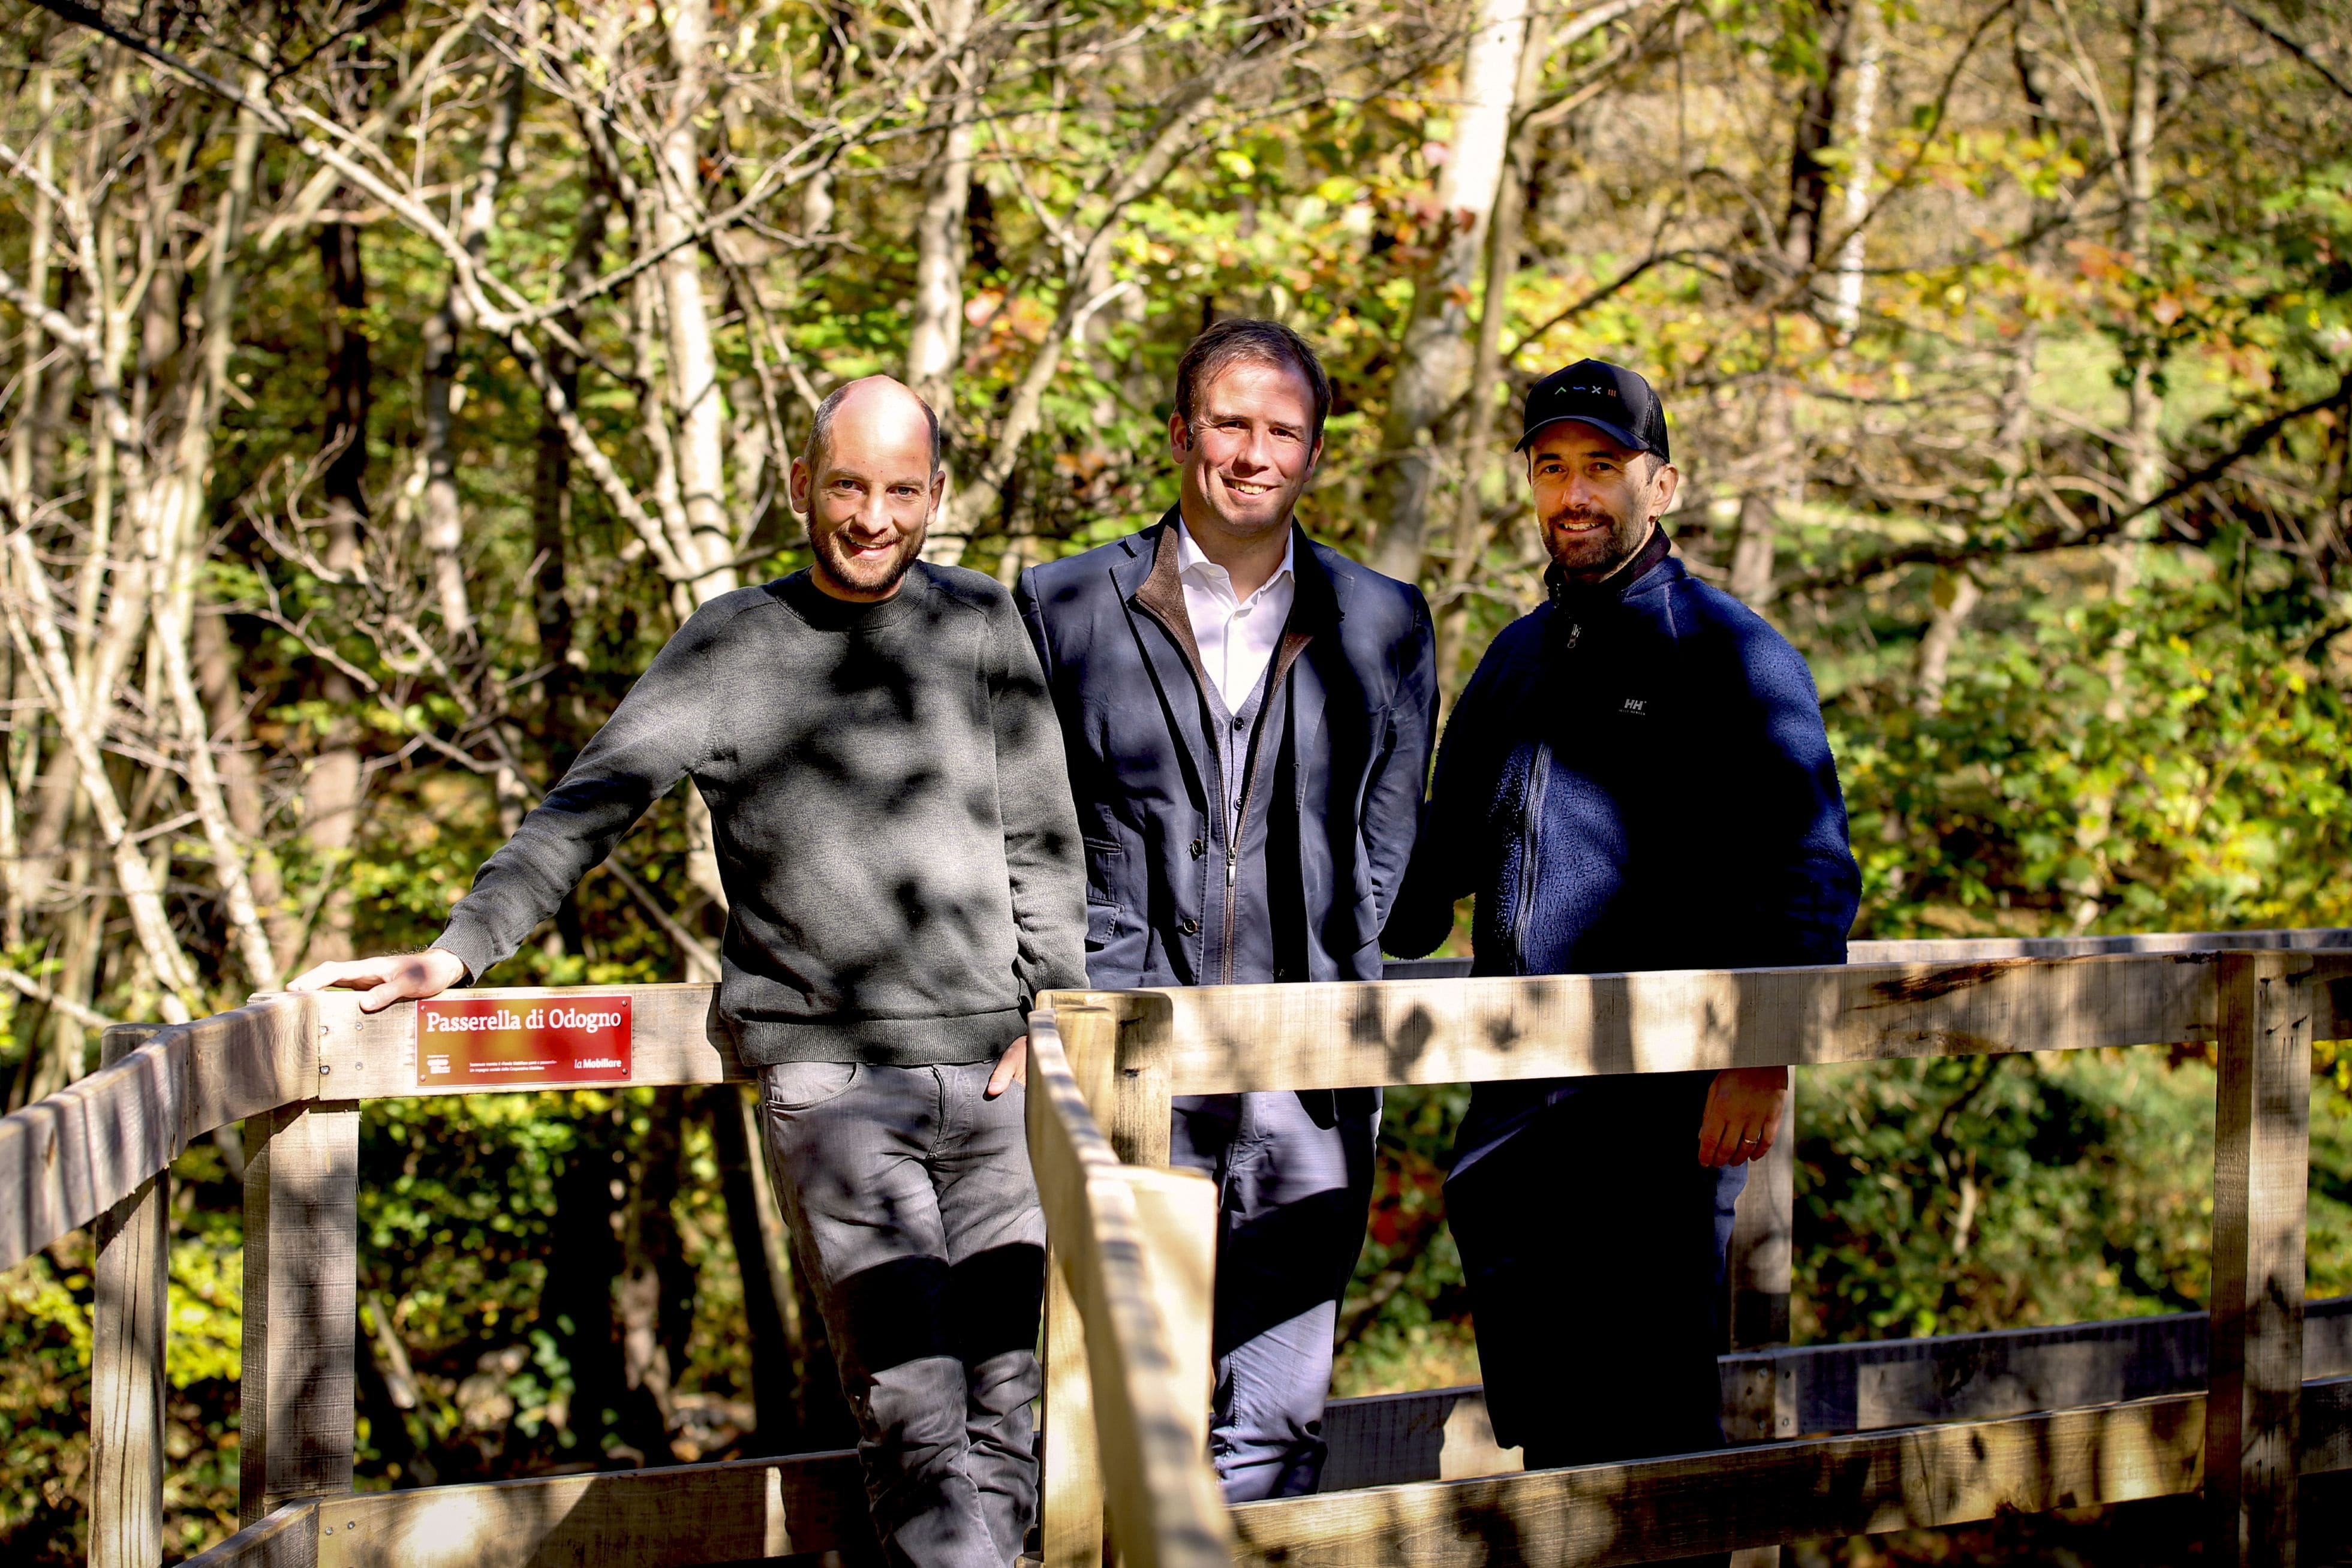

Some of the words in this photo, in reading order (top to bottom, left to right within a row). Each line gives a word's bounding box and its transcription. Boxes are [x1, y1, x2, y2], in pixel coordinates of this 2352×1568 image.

[426, 1009, 522, 1032] Passerella
[525, 1009, 545, 1030] di
[549, 1008, 622, 1033] Odogno
[574, 1059, 582, 1069] la
[583, 1058, 622, 1069] Mobiliare
